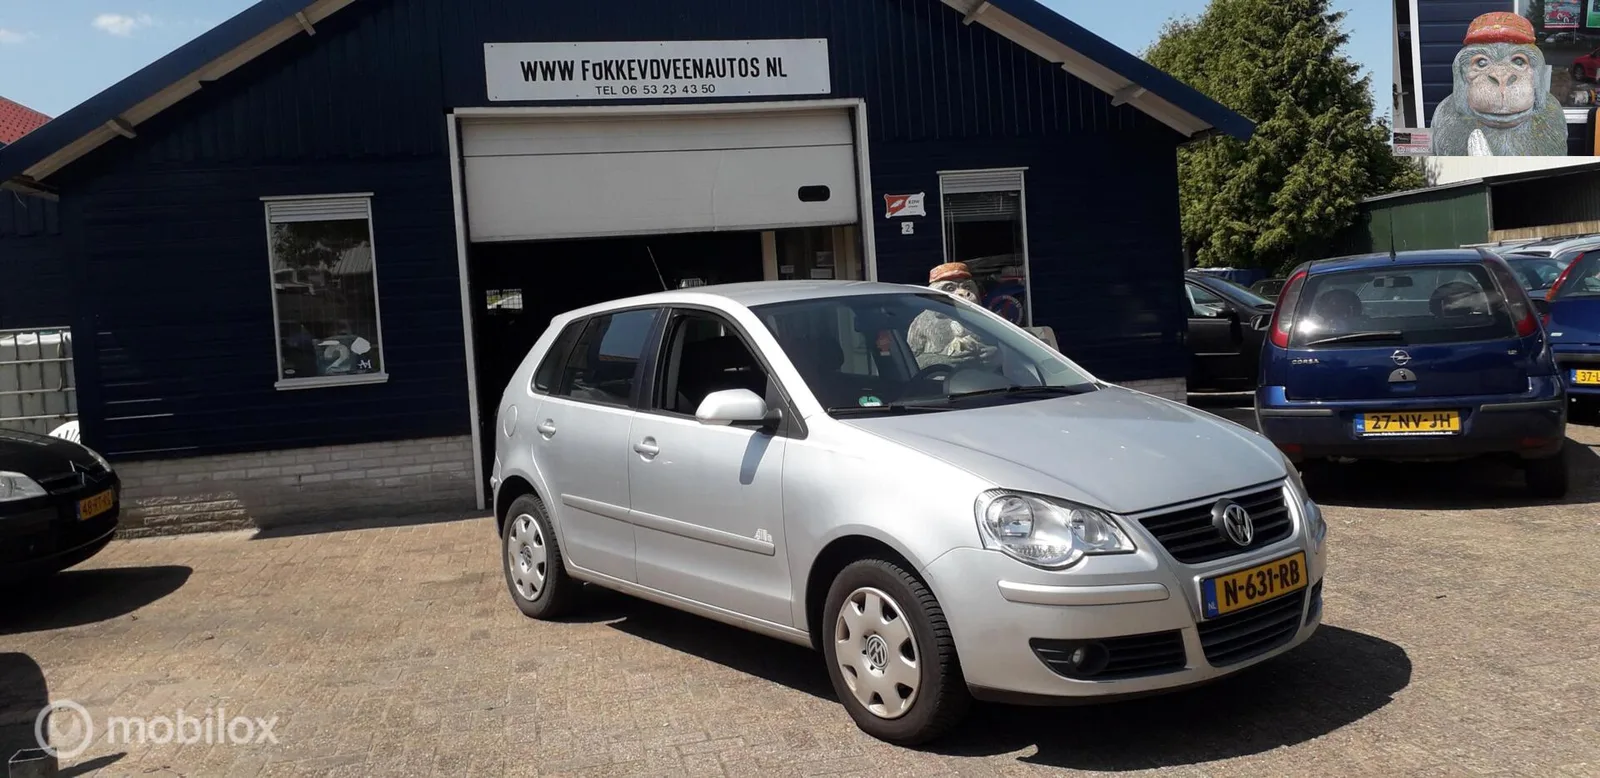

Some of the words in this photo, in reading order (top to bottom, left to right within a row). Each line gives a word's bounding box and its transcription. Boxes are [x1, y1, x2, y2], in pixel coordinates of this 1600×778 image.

[520, 60, 575, 82] WWW
[766, 56, 788, 78] NL
[595, 85, 617, 95] TEL
[621, 85, 638, 95] 06
[643, 84, 658, 95] 53
[662, 84, 677, 95] 23
[682, 84, 698, 94] 43
[701, 83, 716, 94] 50
[904, 224, 911, 233] 2
[1371, 413, 1451, 430] 27-NV-JH
[1223, 559, 1301, 607] N-631-RB
[1208, 602, 1218, 611] NL
